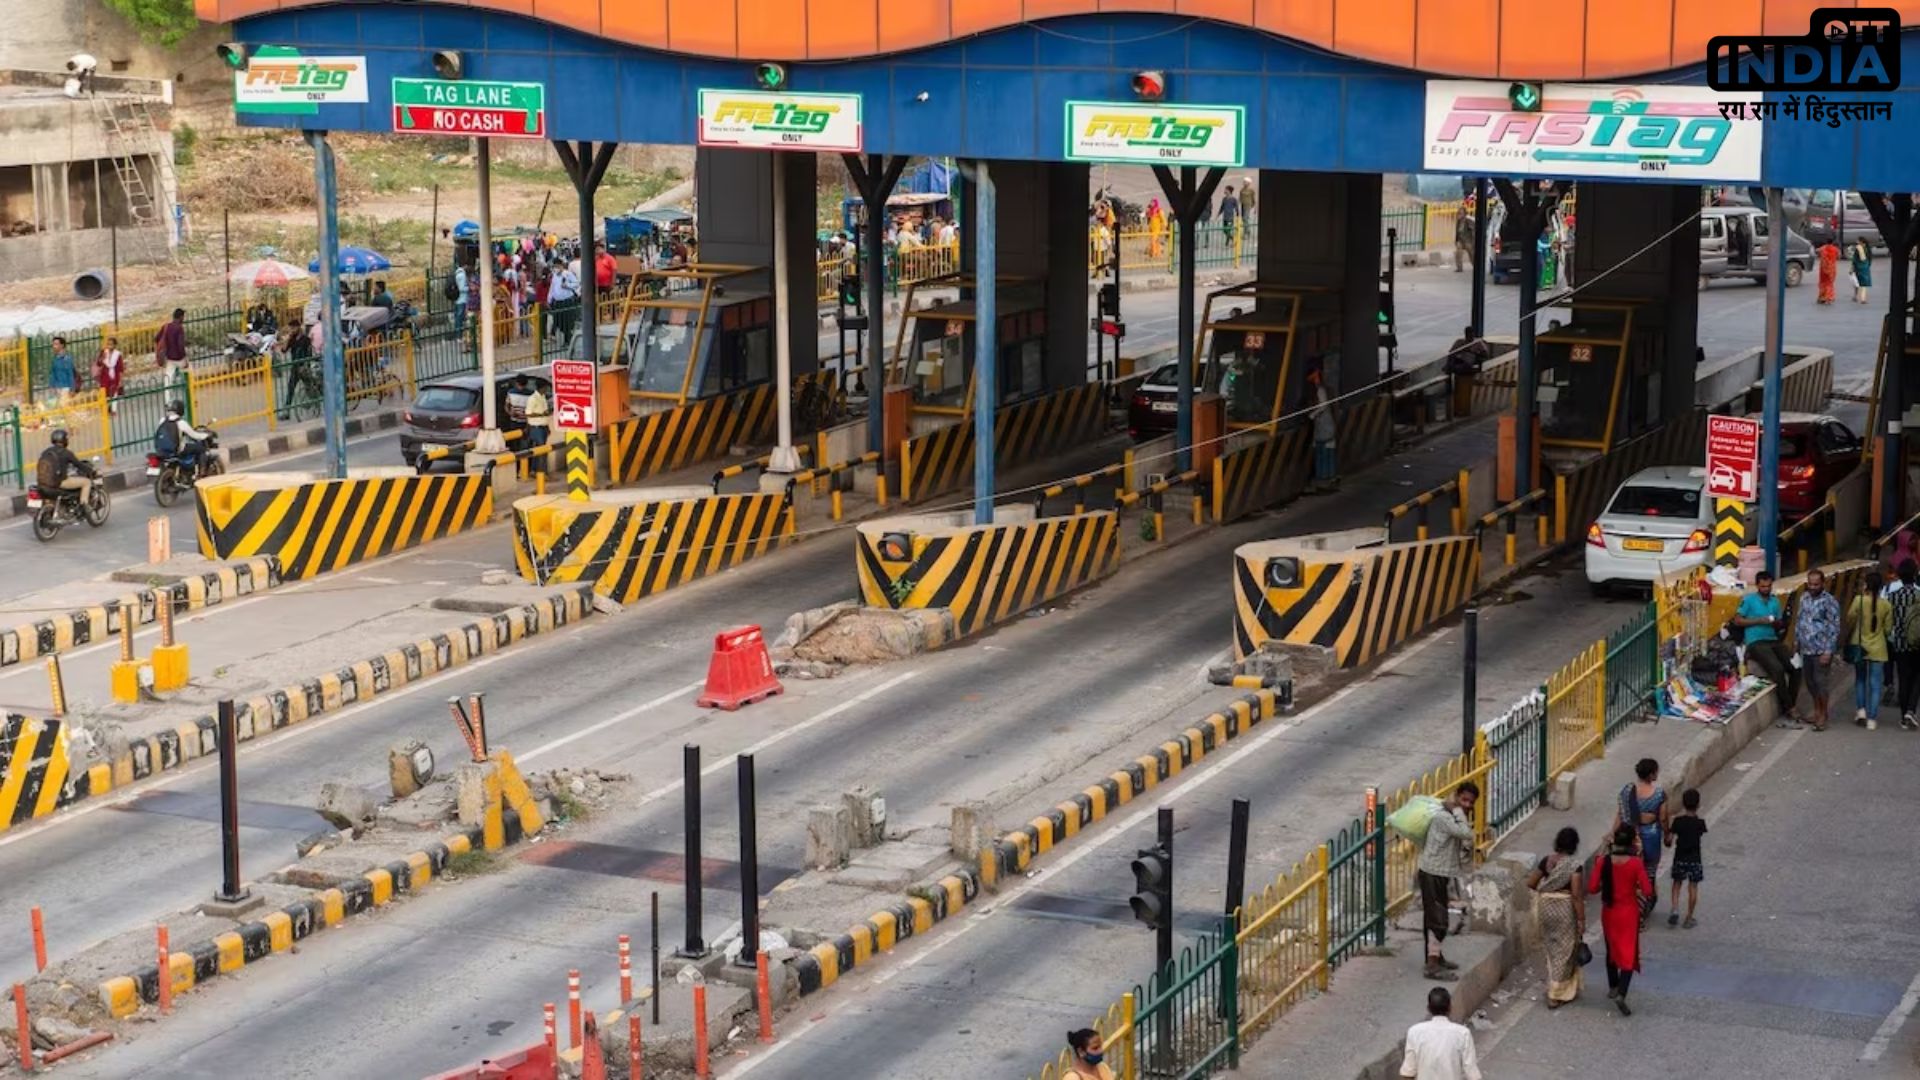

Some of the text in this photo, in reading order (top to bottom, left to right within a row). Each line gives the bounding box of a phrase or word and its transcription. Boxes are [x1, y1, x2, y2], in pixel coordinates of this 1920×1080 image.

[424, 85, 512, 105] TAG LANE
[433, 110, 504, 130] NO CASH
[1437, 96, 1732, 164] FASTag
[781, 133, 803, 142] ONLY
[1159, 148, 1183, 158] ONLY
[1430, 145, 1528, 158] Easy to Cruise
[1641, 161, 1667, 172] ONLY
[1572, 348, 1591, 361] 32
[556, 364, 591, 374] CAUTION
[1711, 420, 1755, 435] CAUTION
